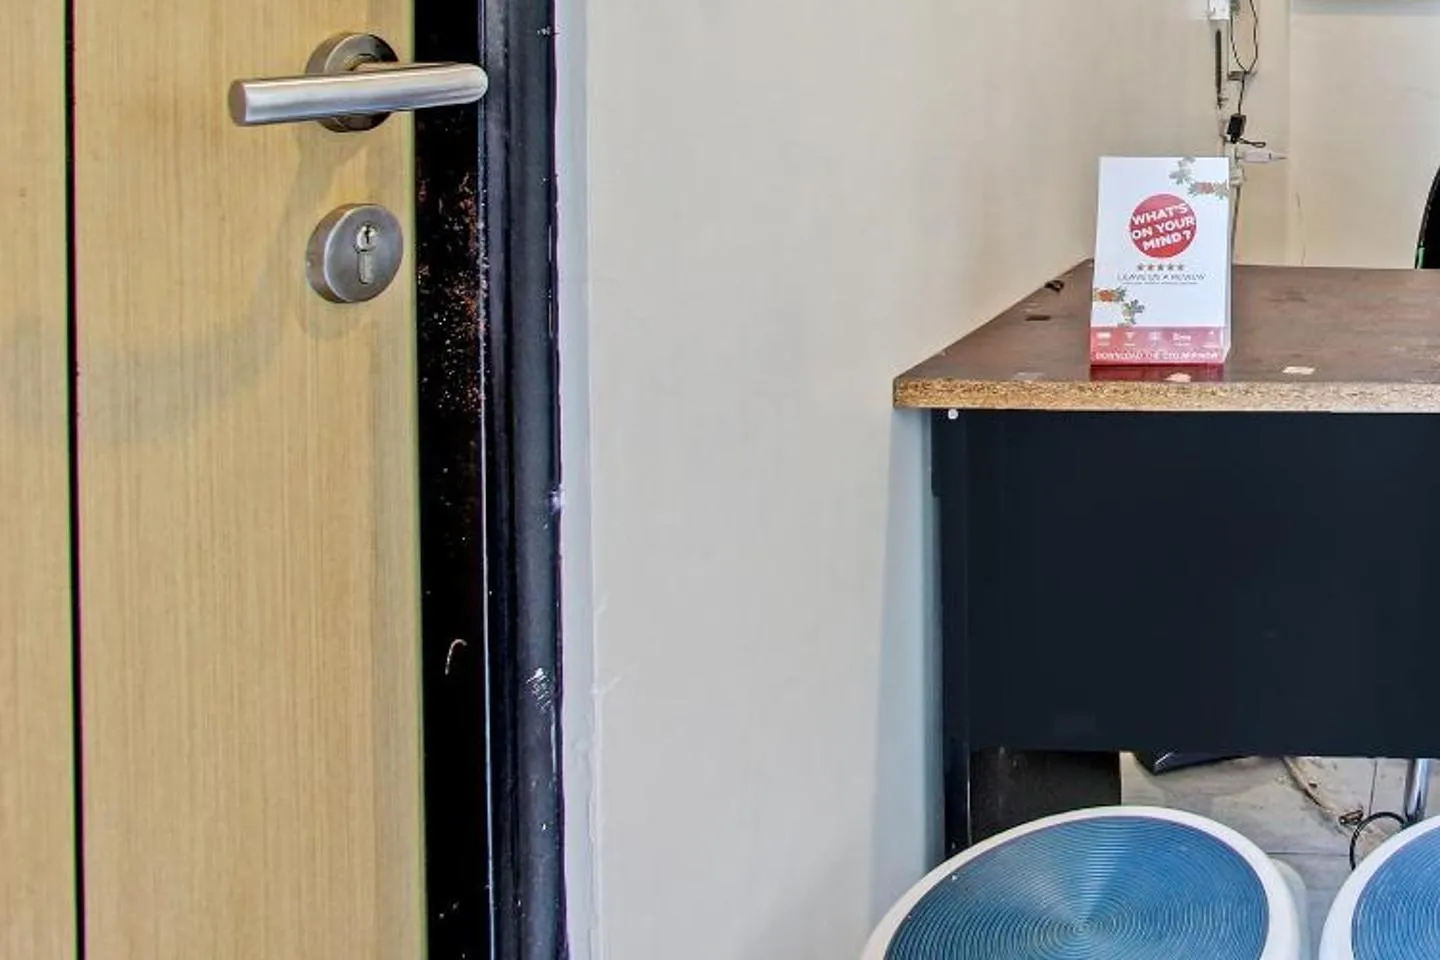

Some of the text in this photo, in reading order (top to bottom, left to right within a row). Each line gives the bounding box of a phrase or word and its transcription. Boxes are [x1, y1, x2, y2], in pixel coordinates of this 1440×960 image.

[1132, 203, 1188, 225] WHAT'S
[1132, 216, 1195, 240] ON YOUR
